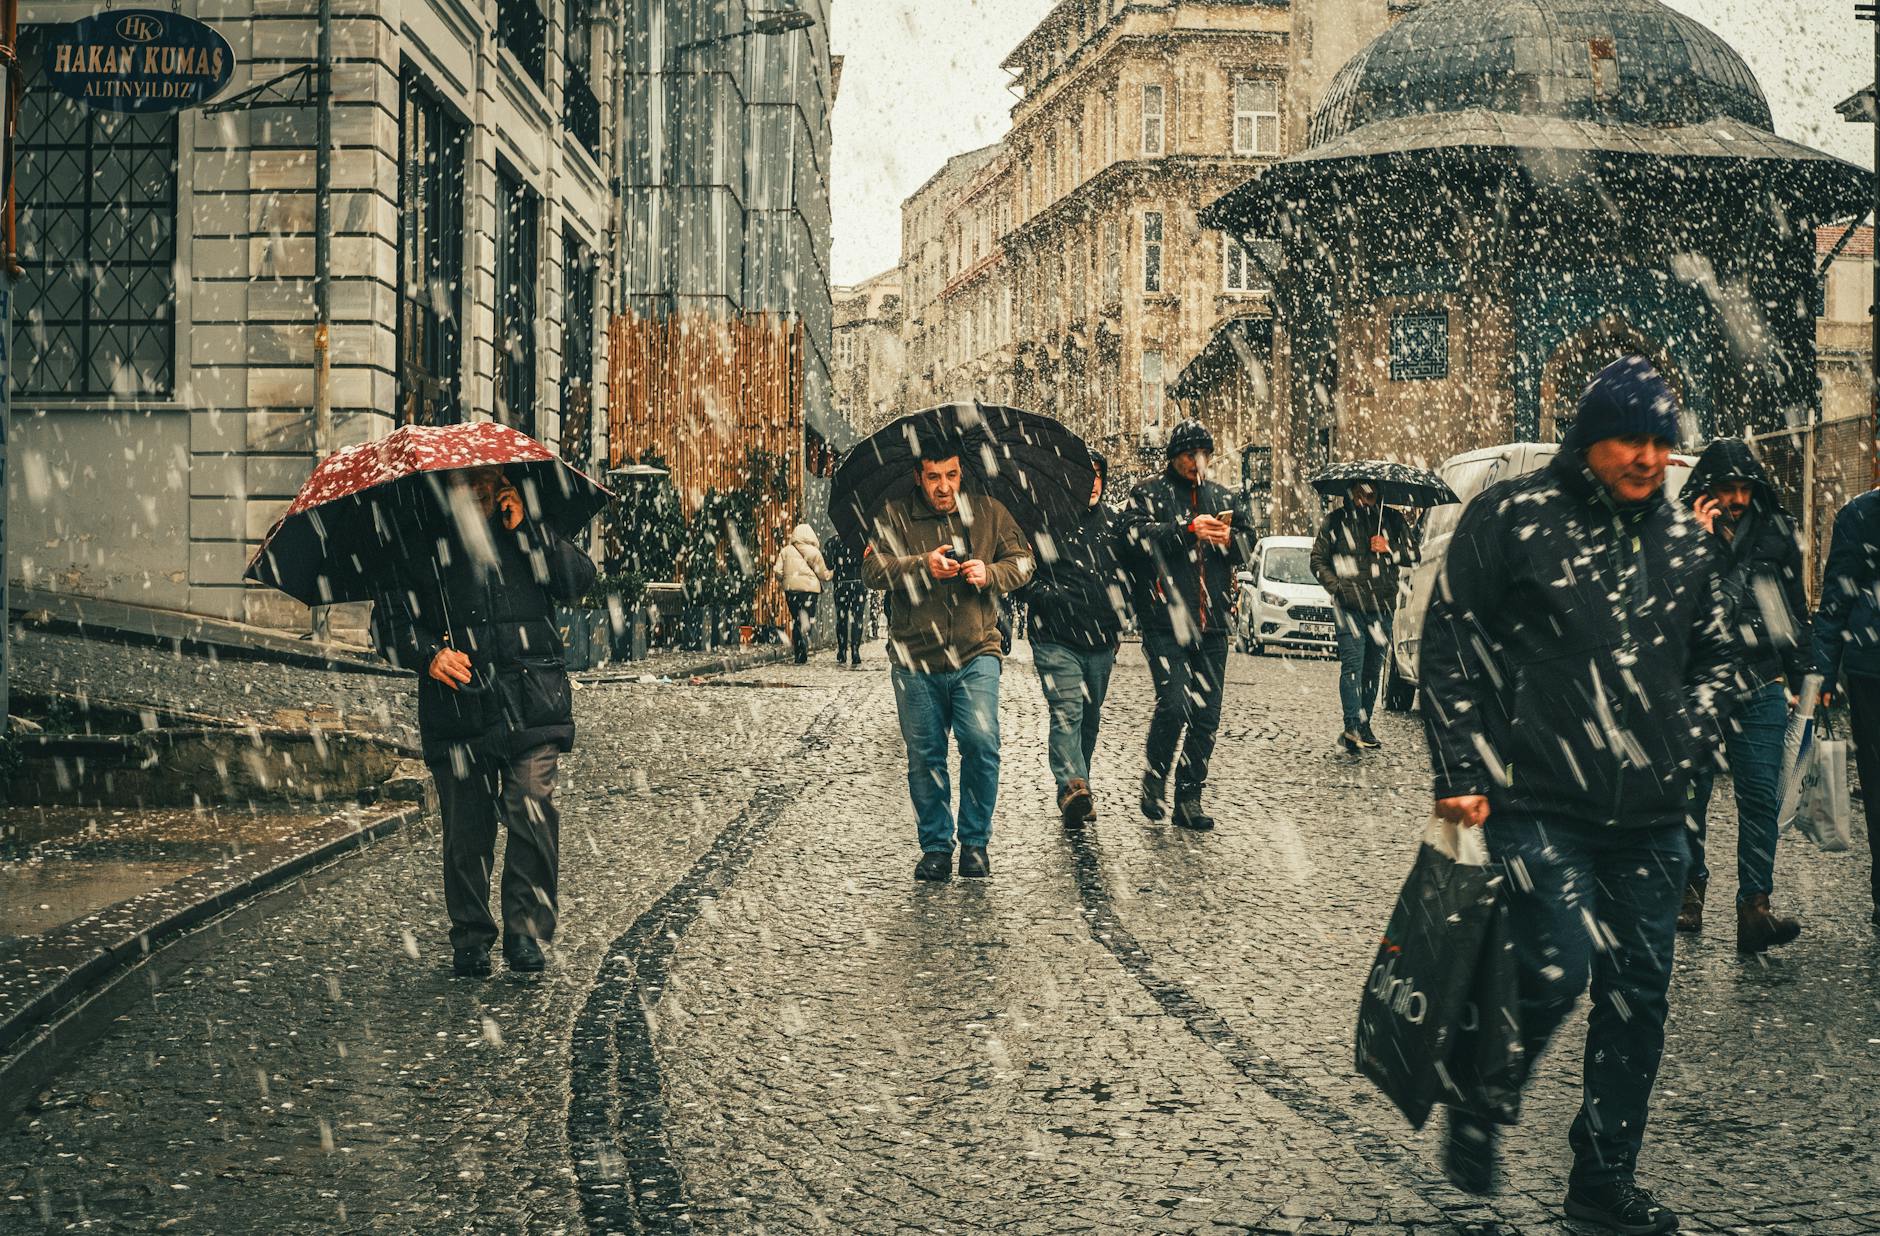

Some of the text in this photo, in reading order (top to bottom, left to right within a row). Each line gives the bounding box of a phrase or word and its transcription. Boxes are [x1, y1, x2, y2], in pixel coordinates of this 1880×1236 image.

[124, 16, 155, 41] HK
[54, 45, 223, 82] HAKAN KUMAŞ
[83, 80, 192, 98] ALTINYILDIZ
